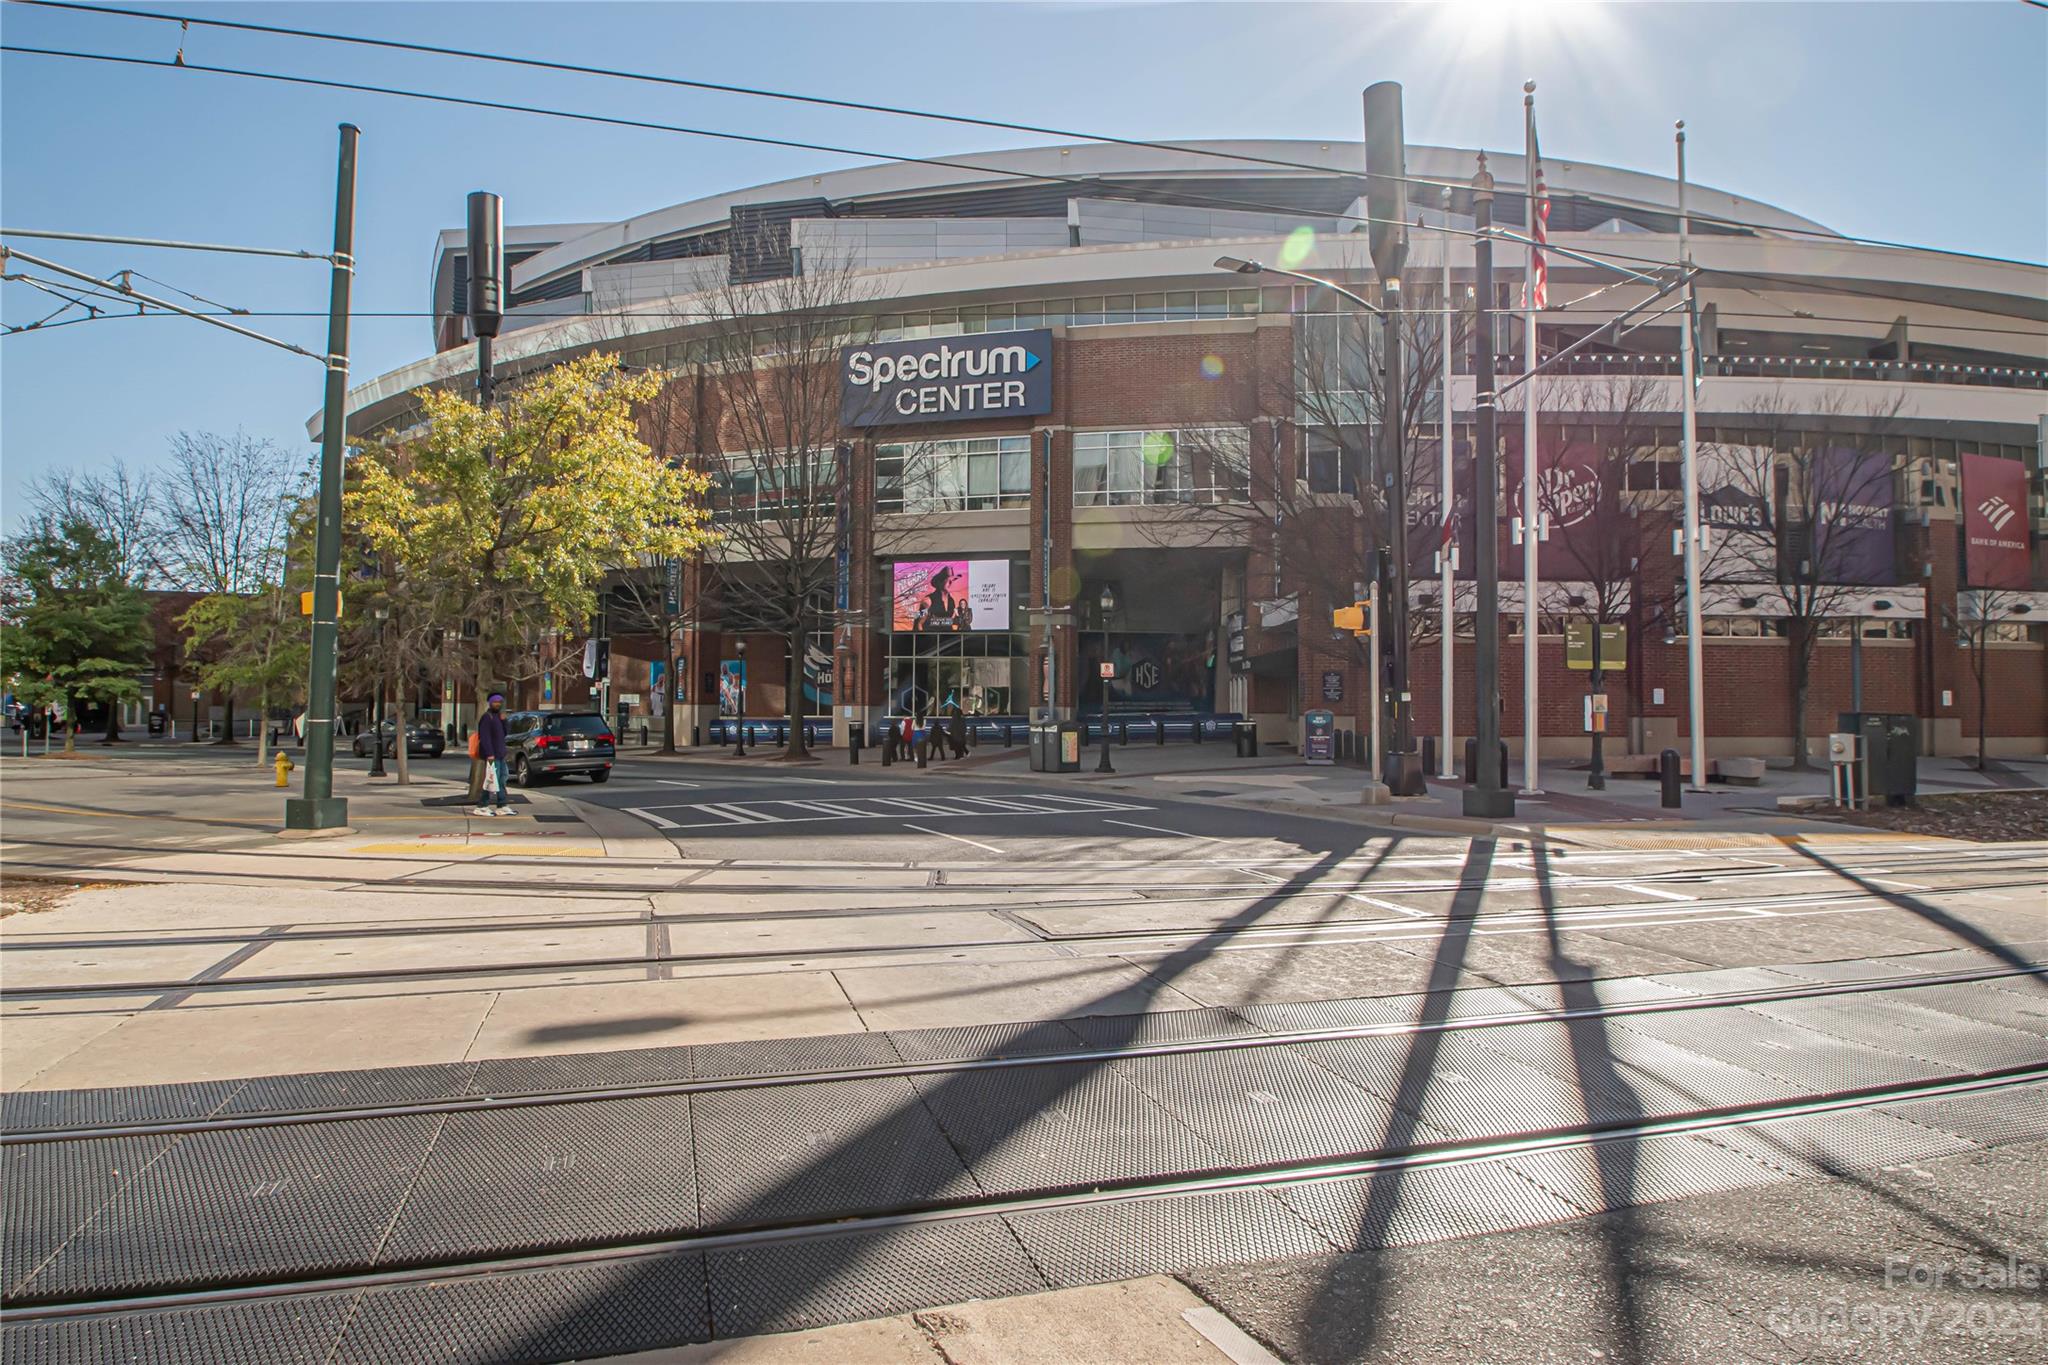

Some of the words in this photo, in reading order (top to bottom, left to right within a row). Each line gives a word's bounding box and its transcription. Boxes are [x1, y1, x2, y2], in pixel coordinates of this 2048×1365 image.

[849, 345, 1027, 392] Spectrum
[896, 380, 1026, 416] CENTER
[1971, 537, 1989, 546] BANK
[1989, 538, 1998, 547] OF
[1998, 540, 2025, 550] AMERICA
[1135, 662, 1160, 689] HSE
